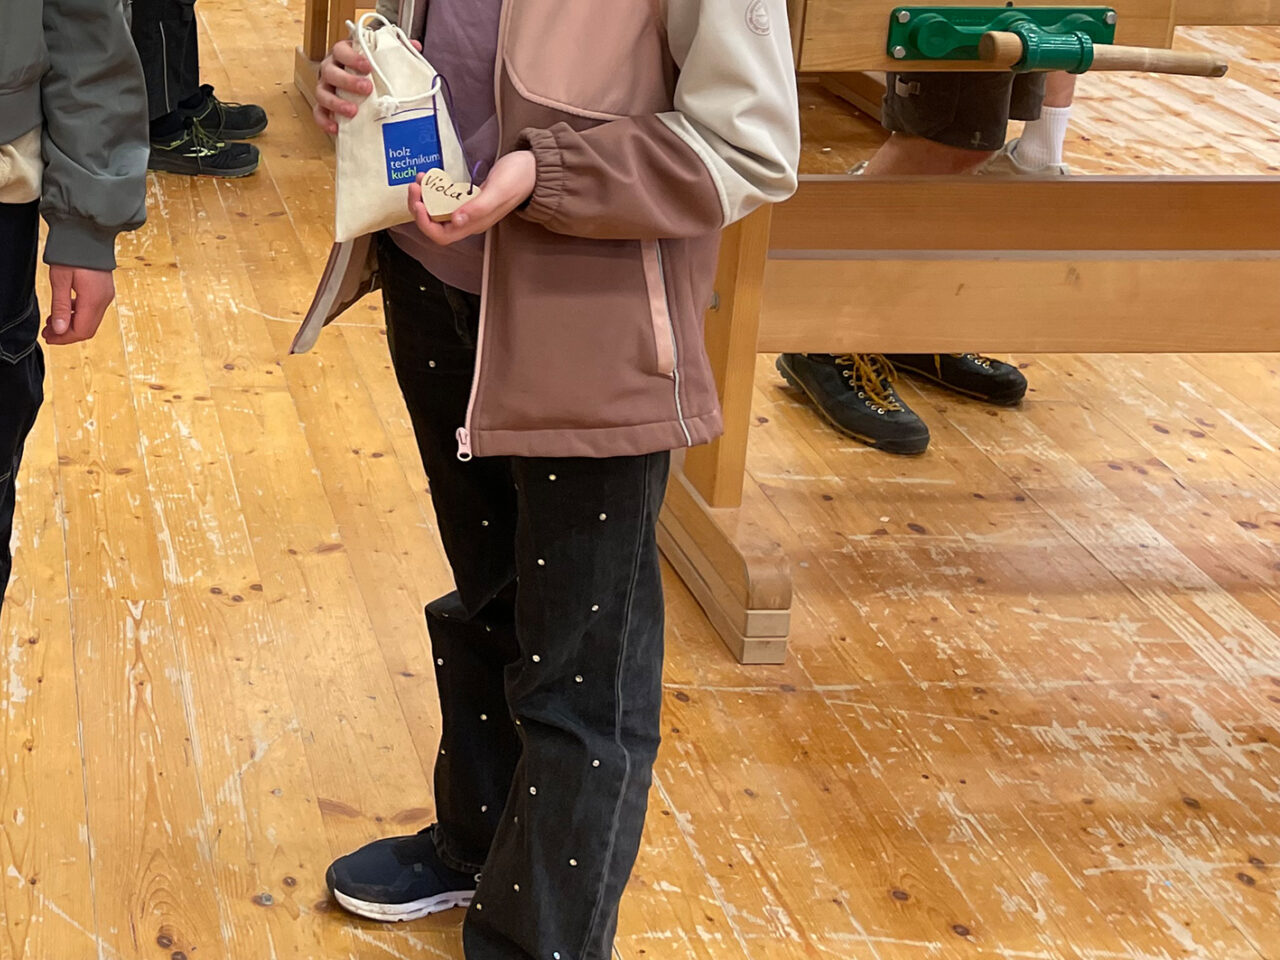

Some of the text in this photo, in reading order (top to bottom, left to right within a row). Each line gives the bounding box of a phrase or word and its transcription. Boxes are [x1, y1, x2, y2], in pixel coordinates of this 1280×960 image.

[389, 146, 411, 158] holz
[390, 153, 440, 169] technikum
[391, 166, 417, 180] kuchl
[425, 175, 462, 201] Viola
